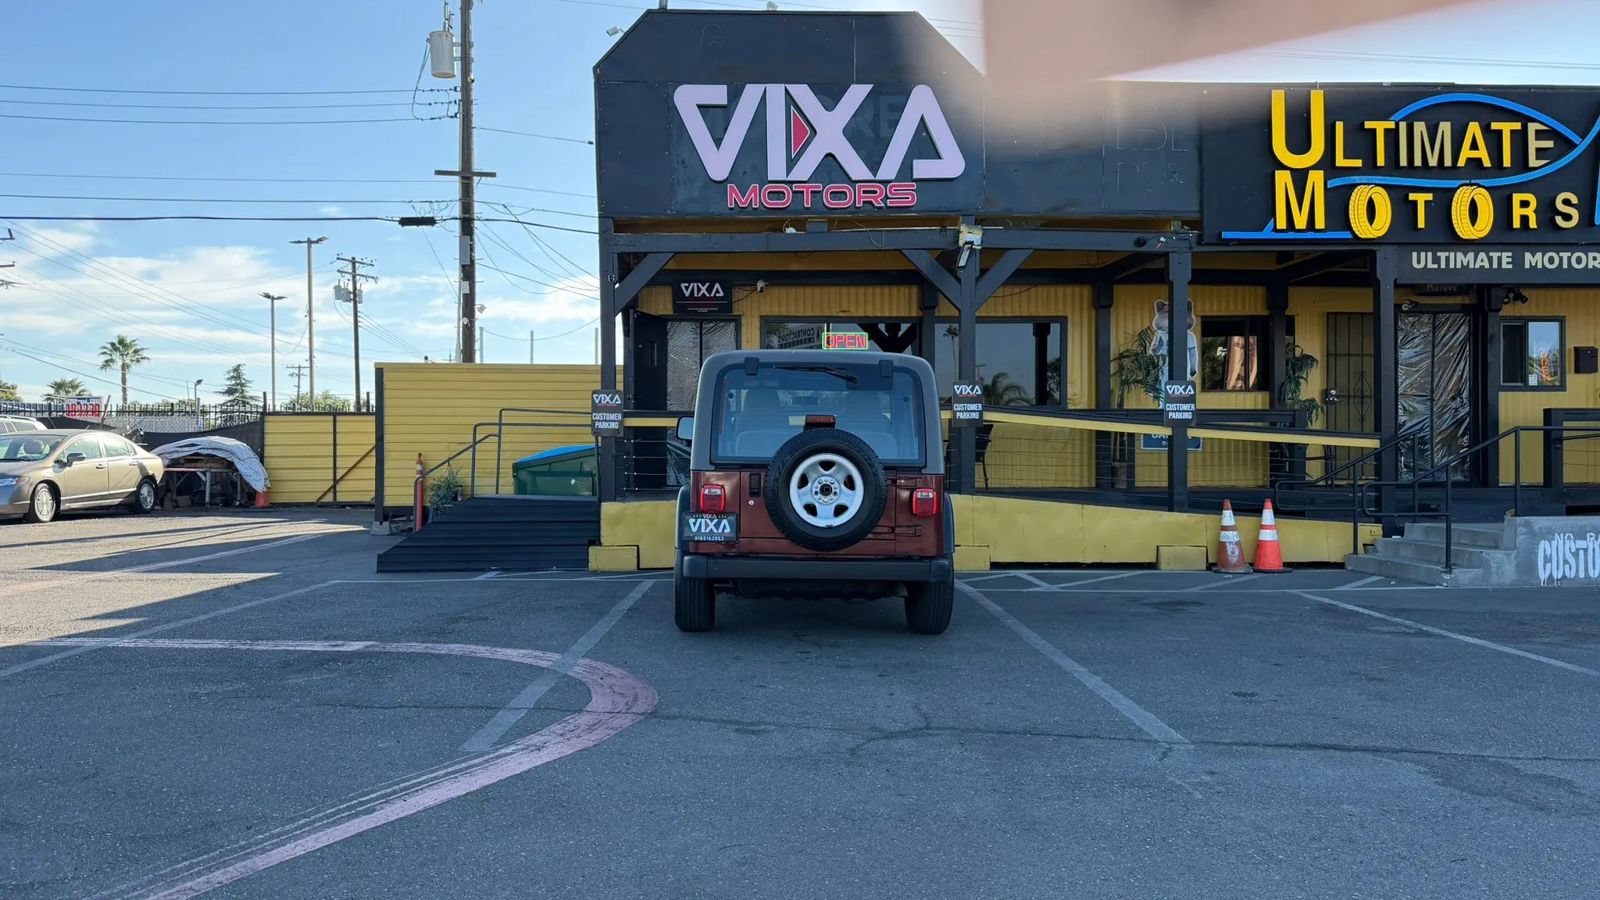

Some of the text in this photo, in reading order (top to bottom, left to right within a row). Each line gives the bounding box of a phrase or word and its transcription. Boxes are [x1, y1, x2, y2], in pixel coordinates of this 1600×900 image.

[673, 83, 966, 182] VIXA
[1271, 89, 1555, 169] ULTIMATE
[727, 182, 918, 208] MOTORS
[1275, 170, 1580, 240] MOTORS
[1411, 251, 1513, 269] ULTIMATE
[680, 282, 725, 297] VIXA
[825, 335, 866, 348] OPEN
[953, 385, 982, 395] VIXA
[1166, 385, 1195, 395] VIXA
[592, 394, 622, 404] VIXA
[953, 403, 983, 411] CUSTOMER
[1165, 403, 1195, 411] CUSTOMER
[592, 413, 622, 421] CUSTOMER
[956, 412, 980, 420] PARKING
[1168, 412, 1193, 420] PARKING
[594, 421, 620, 429] PARKING
[688, 518, 731, 533] VIXA
[1537, 540, 1600, 579] CUSTO
